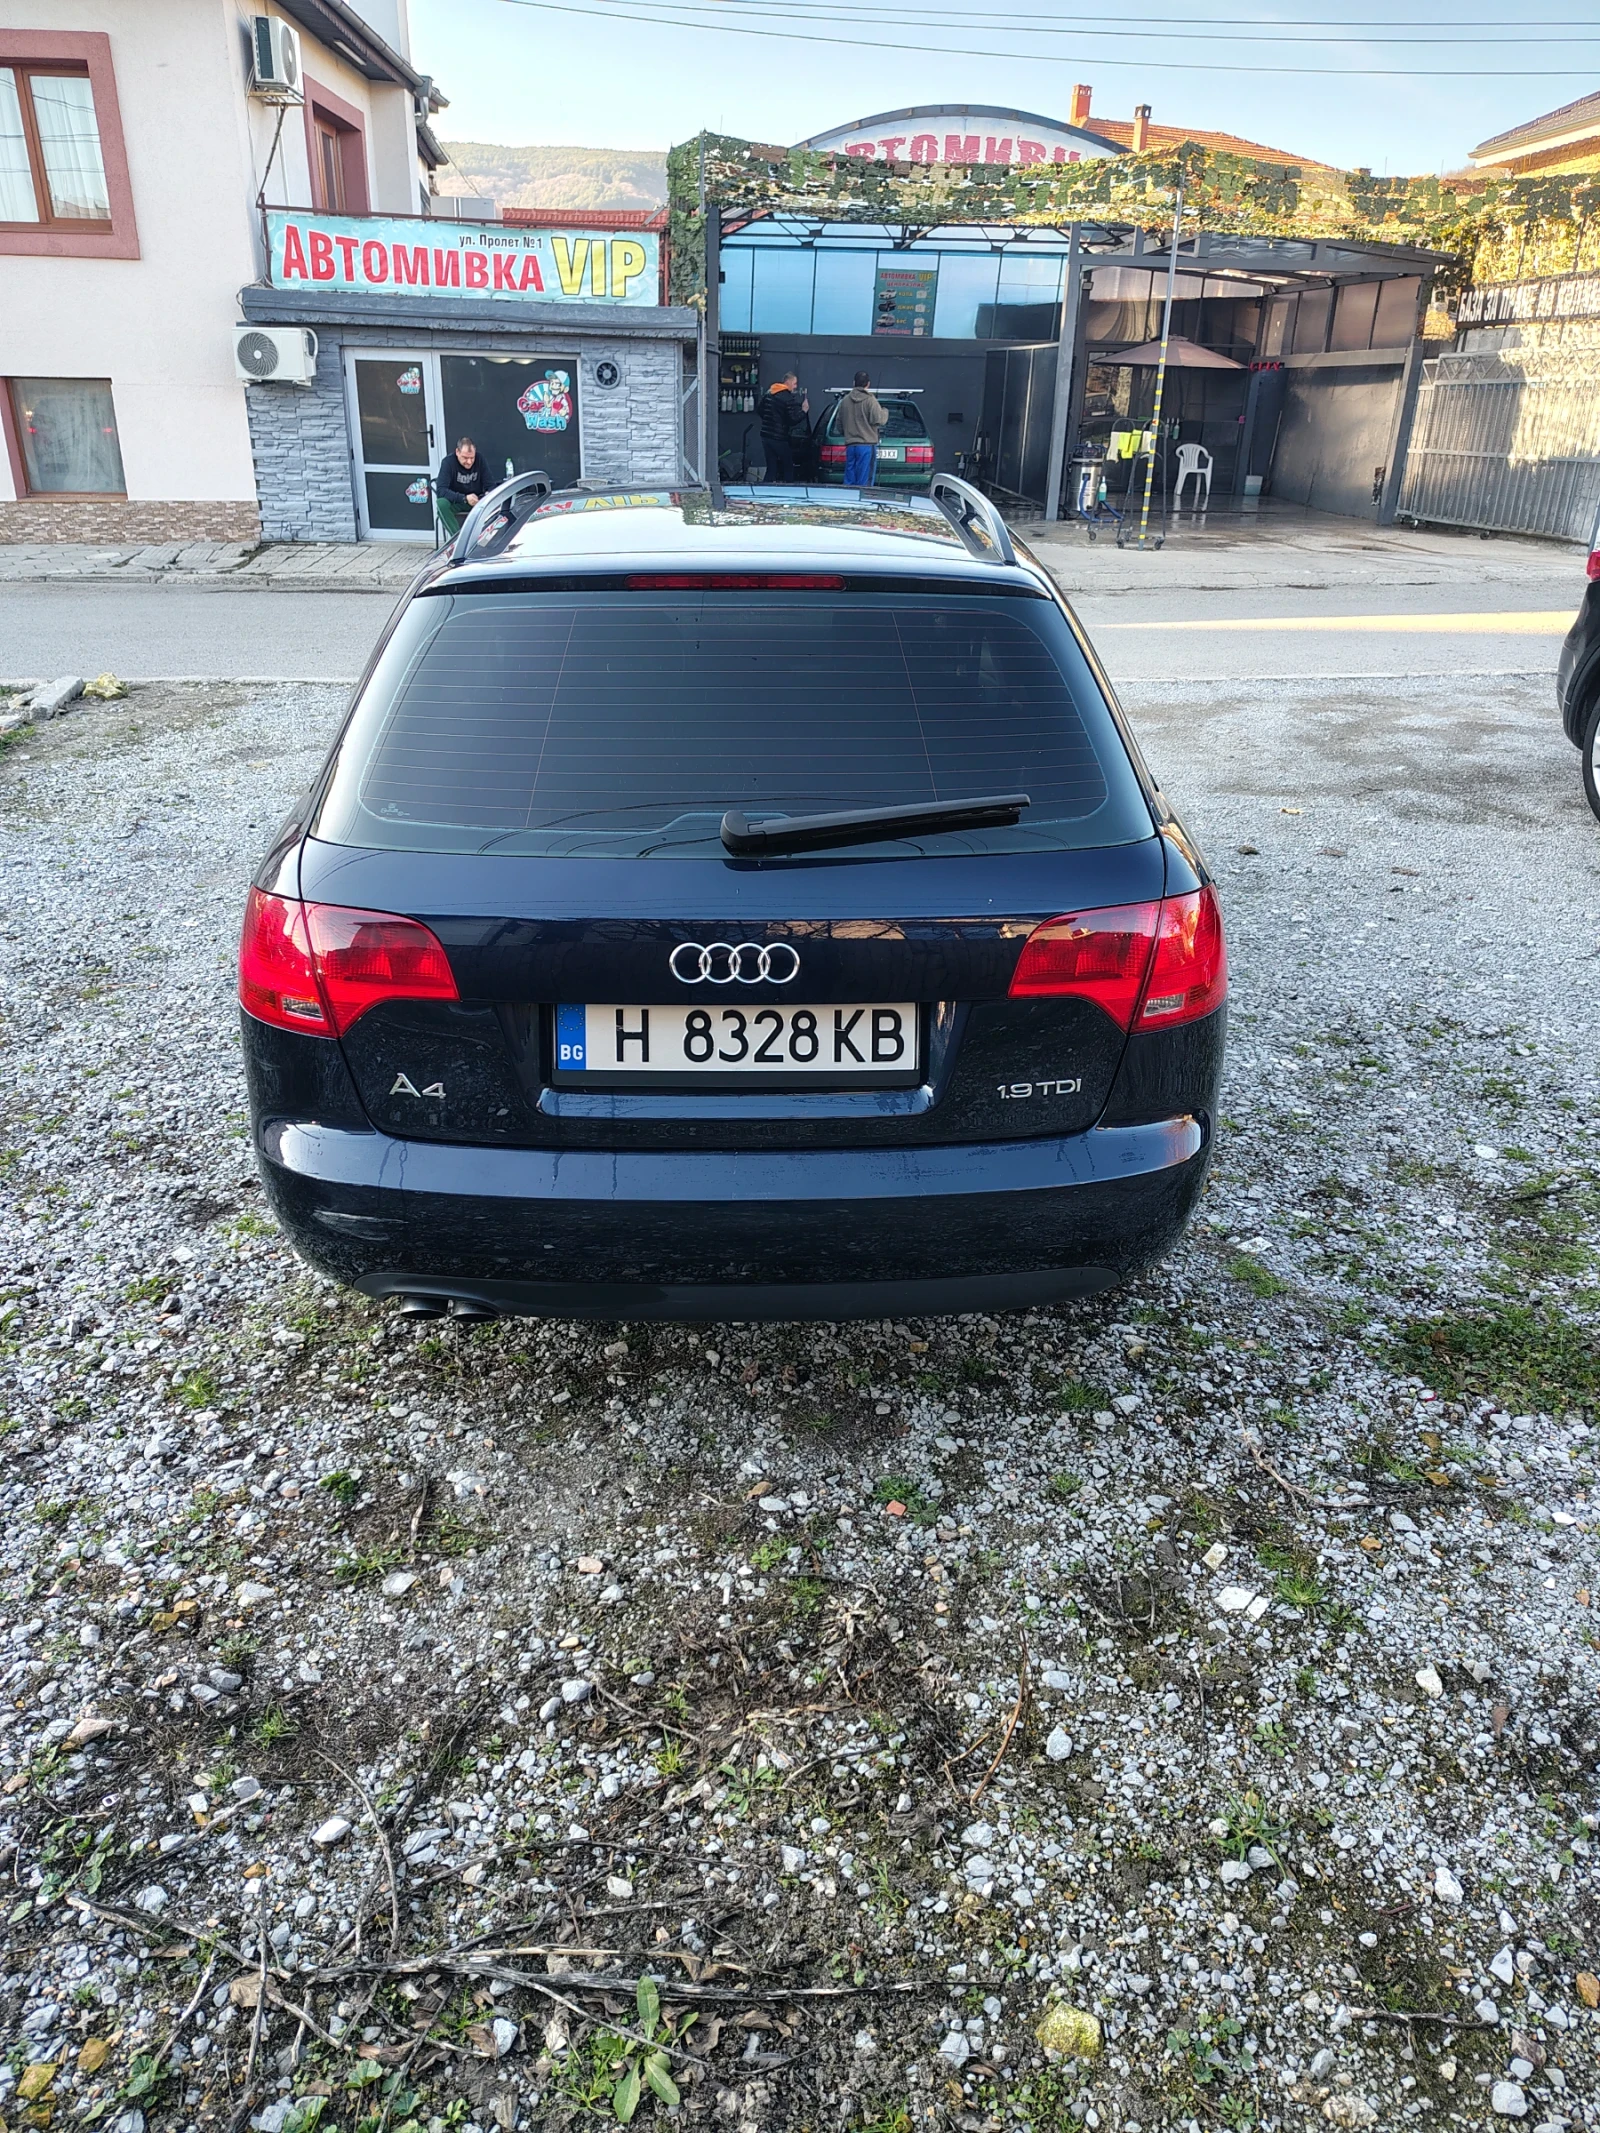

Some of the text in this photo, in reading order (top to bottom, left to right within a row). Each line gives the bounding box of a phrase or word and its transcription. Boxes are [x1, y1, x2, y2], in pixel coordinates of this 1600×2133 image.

[459, 234, 543, 249] ул. Пролет №1
[283, 224, 646, 298] АВТОМИВКА VIP
[918, 272, 932, 281] VIP
[1458, 289, 1485, 322] БАЗА
[1483, 287, 1501, 321] ЗА
[517, 397, 545, 412] Car
[525, 412, 567, 430] Wash
[560, 1044, 584, 1061] BG
[389, 1072, 447, 1099] A4
[996, 1078, 1082, 1099] 1.9 TDI
